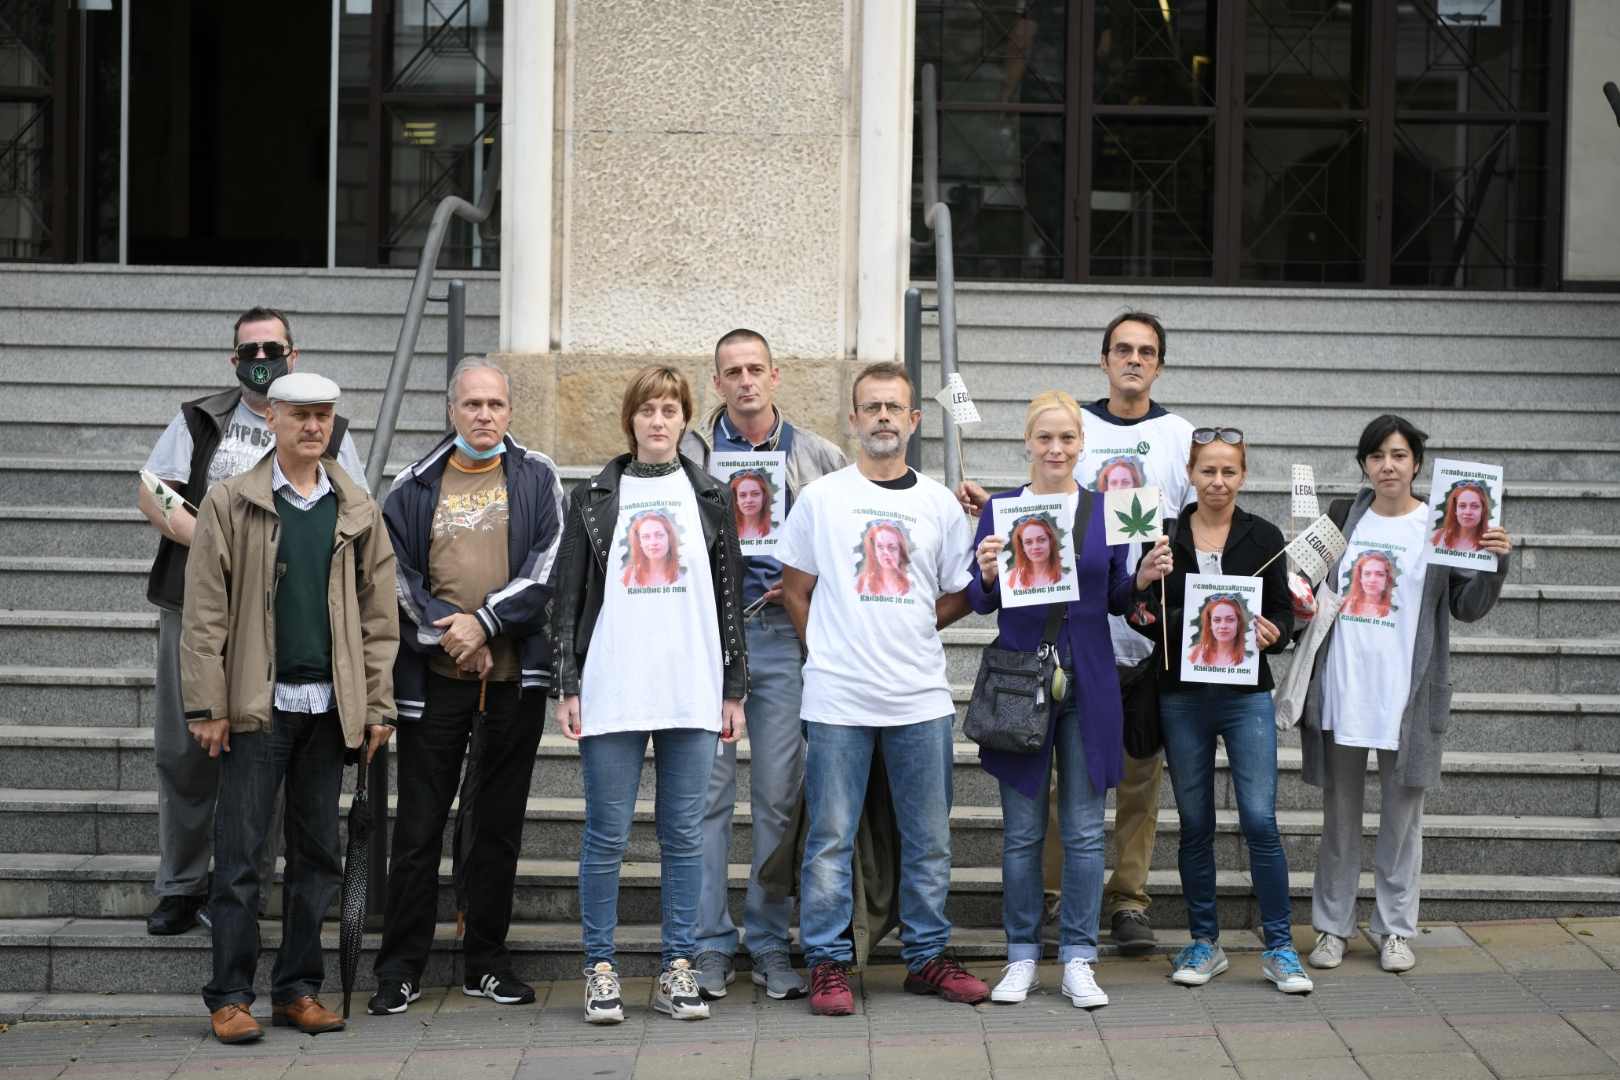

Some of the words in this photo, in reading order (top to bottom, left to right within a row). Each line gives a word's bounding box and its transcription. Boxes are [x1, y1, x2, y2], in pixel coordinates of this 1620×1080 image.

[1435, 547, 1467, 557] Канабис
[1477, 553, 1492, 561] лек
[627, 586, 662, 595] Канабис
[1013, 586, 1047, 596] Канабис
[1056, 584, 1071, 592] лек
[860, 594, 895, 603] Канабис
[1341, 614, 1372, 624] Канабис
[1381, 620, 1396, 628] лек
[1193, 664, 1227, 673] Канабис
[1236, 667, 1251, 675] лек
